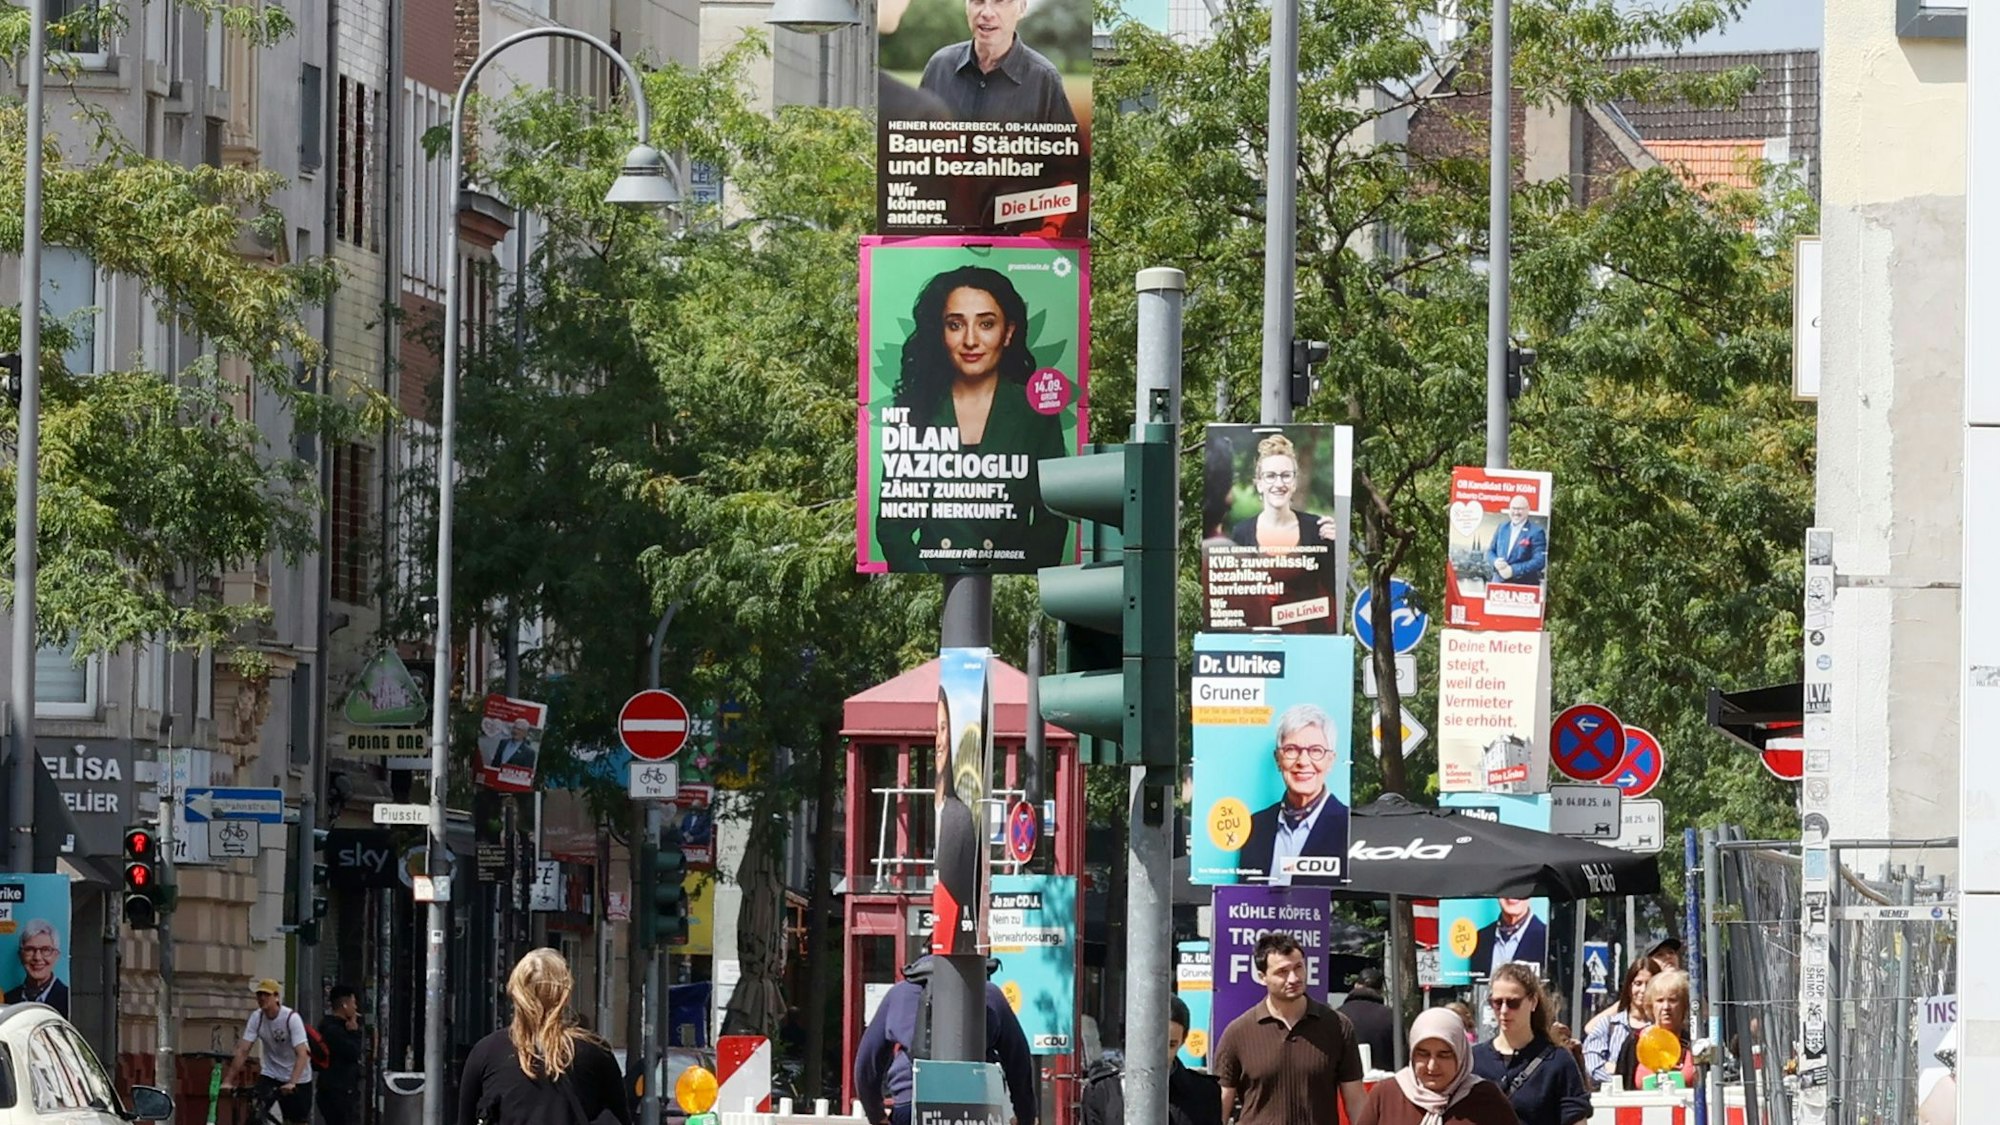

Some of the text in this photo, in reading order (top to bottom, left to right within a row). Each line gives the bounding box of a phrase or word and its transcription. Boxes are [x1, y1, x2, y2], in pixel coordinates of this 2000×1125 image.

[888, 121, 1078, 133] HEINER KOCKERBECK, OB-KANDIDAT
[888, 134, 1079, 155] Bauen! Städtisch
[888, 156, 1044, 176] und bezahlbar
[887, 196, 947, 211] können
[1001, 192, 1072, 216] Die Linke
[887, 211, 948, 224] anders.
[1034, 379, 1062, 394] 14.09.
[882, 407, 911, 423] MIT
[882, 453, 1029, 479] YAZICIOGLU
[881, 480, 1009, 501] ZÄHLT ZUKUNFT,
[1515, 483, 1537, 493] Köln
[881, 503, 1018, 519] NICHT HERKUNFT.
[919, 548, 1026, 560] ZUSAMMEN FÜR DAS MORGEN.
[1208, 555, 1319, 571] KVB: zuverlässig,
[1208, 569, 1272, 583] bezahlbar,
[1209, 582, 1284, 595] barrierefrei!
[1210, 608, 1244, 618] können
[1277, 604, 1325, 621] Die Linke
[1448, 639, 1533, 654] Deine Miete
[1199, 655, 1282, 675] Dr. Ulrike
[1447, 659, 1489, 674] steigt,
[1446, 677, 1506, 690] weil dein
[1200, 684, 1260, 701] Gruner
[1445, 694, 1514, 709] Vermieter
[1444, 714, 1518, 728] sie erhöht.
[646, 786, 661, 795] frei
[1553, 798, 1563, 806] ab
[381, 807, 424, 821] Piusstr.
[1220, 806, 1234, 817] 3x
[1461, 808, 1498, 823] ike
[1216, 818, 1241, 831] CDU
[1348, 838, 1454, 860] kola
[338, 841, 389, 873] sky
[1296, 860, 1337, 872] CDU
[992, 895, 1002, 907] Ja
[1002, 897, 1016, 908] zur
[993, 914, 1021, 924] Nein zu
[1228, 903, 1321, 921] KÜHLE KÖPFE &
[992, 931, 1063, 945] Verwahrlosung.
[1455, 933, 1471, 943] CDU
[1181, 953, 1194, 963] Dr.
[1043, 1036, 1067, 1046] CDU
